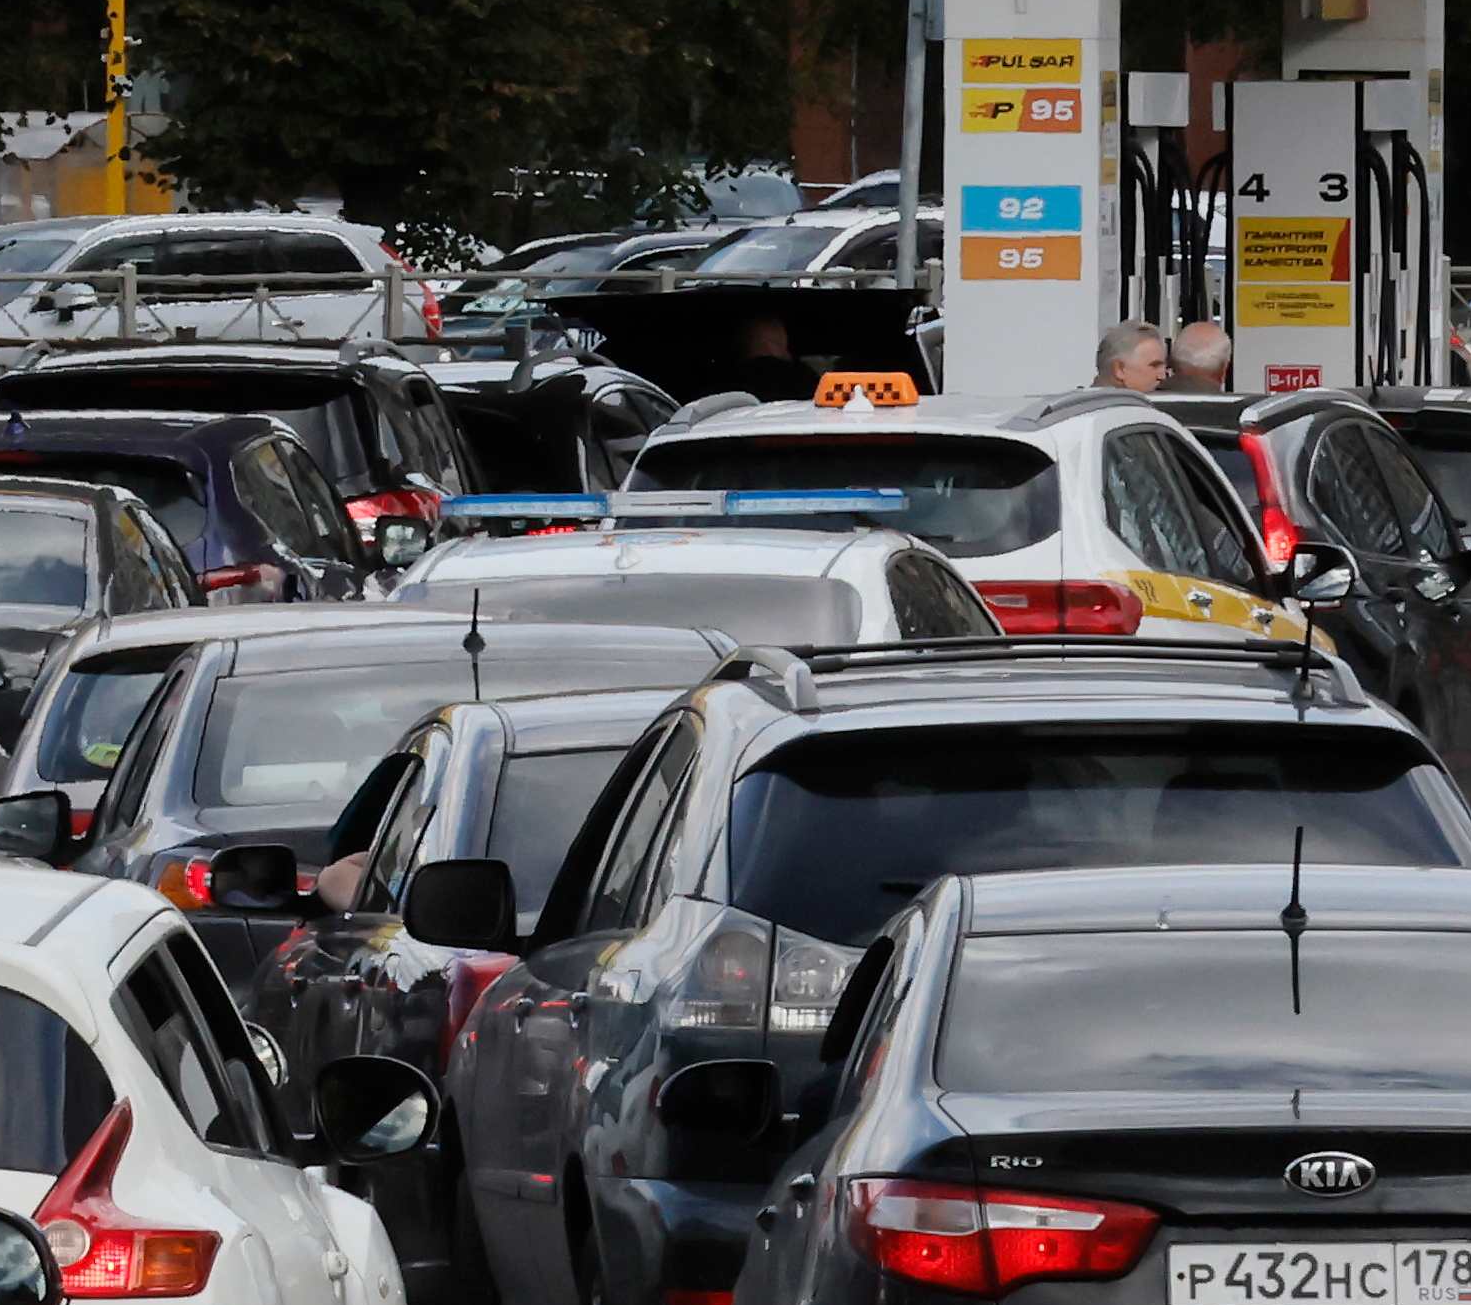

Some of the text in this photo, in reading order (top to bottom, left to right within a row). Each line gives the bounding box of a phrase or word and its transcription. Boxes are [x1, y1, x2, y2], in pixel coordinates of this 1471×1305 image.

[985, 54, 1075, 69] PULSAR
[1030, 98, 1076, 121] 95
[1238, 172, 1349, 203] 4 3
[998, 197, 1045, 221] 92
[1244, 230, 1325, 241] ГАРАНТИЯ
[998, 247, 1045, 270] 95
[1244, 244, 1328, 255] КОНТРОЛЯ
[1244, 258, 1324, 268] КАЧЕСТВА
[1299, 1161, 1361, 1188] KIA
[1189, 1251, 1388, 1300] Р432НС
[1418, 1287, 1456, 1301] RUS
